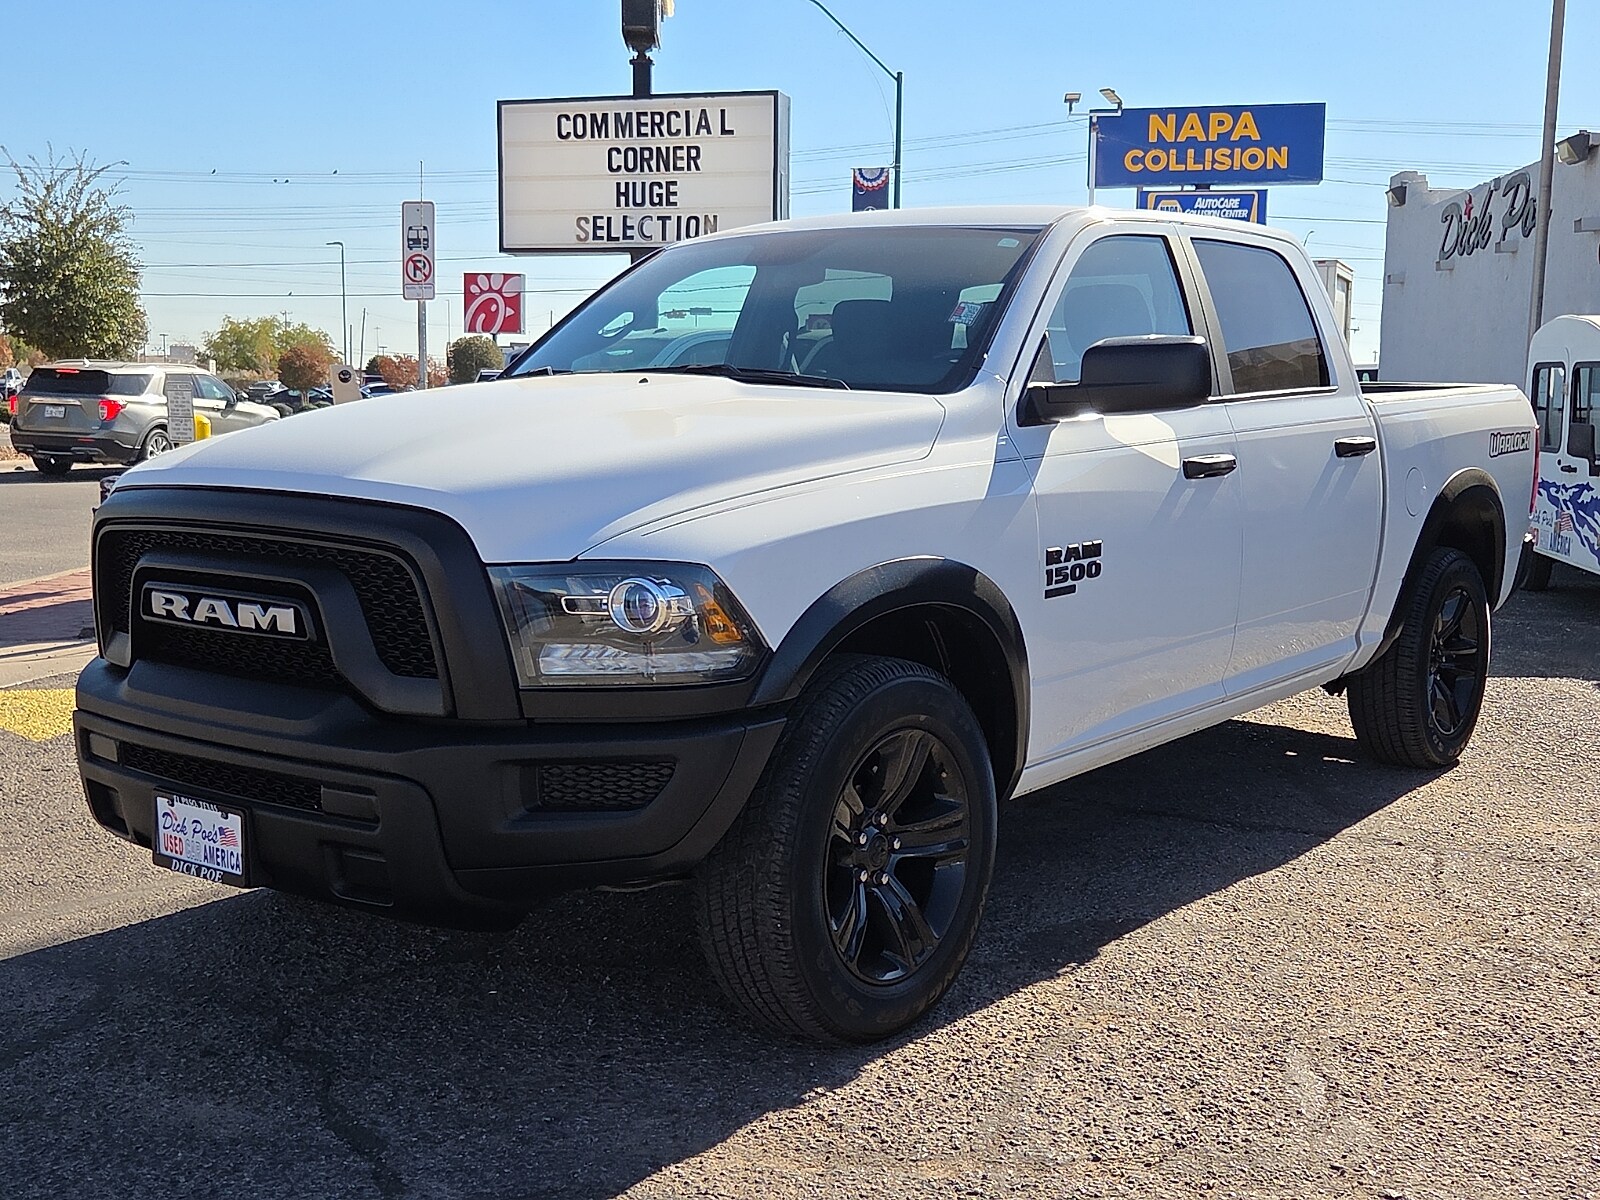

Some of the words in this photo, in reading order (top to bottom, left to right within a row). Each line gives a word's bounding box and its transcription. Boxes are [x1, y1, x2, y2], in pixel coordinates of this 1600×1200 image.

[557, 108, 735, 139] COMMERCIAL
[1148, 111, 1261, 143] NAPA
[607, 145, 701, 173] CORNER
[1124, 146, 1289, 172] COLLISION
[615, 180, 678, 208] HUGE
[575, 214, 718, 242] SELECTION
[1439, 176, 1499, 261] Dick
[1502, 172, 1545, 242] Po
[1489, 431, 1531, 457] WARLOCK
[1046, 539, 1103, 566] RAM
[1045, 560, 1102, 587] 1500
[151, 590, 296, 634] RAM
[162, 810, 188, 836] Dick
[191, 819, 220, 844] Poe's
[163, 832, 184, 856] USED
[203, 844, 241, 872] AMERICA
[171, 859, 198, 876] DICK
[199, 864, 224, 883] POE
